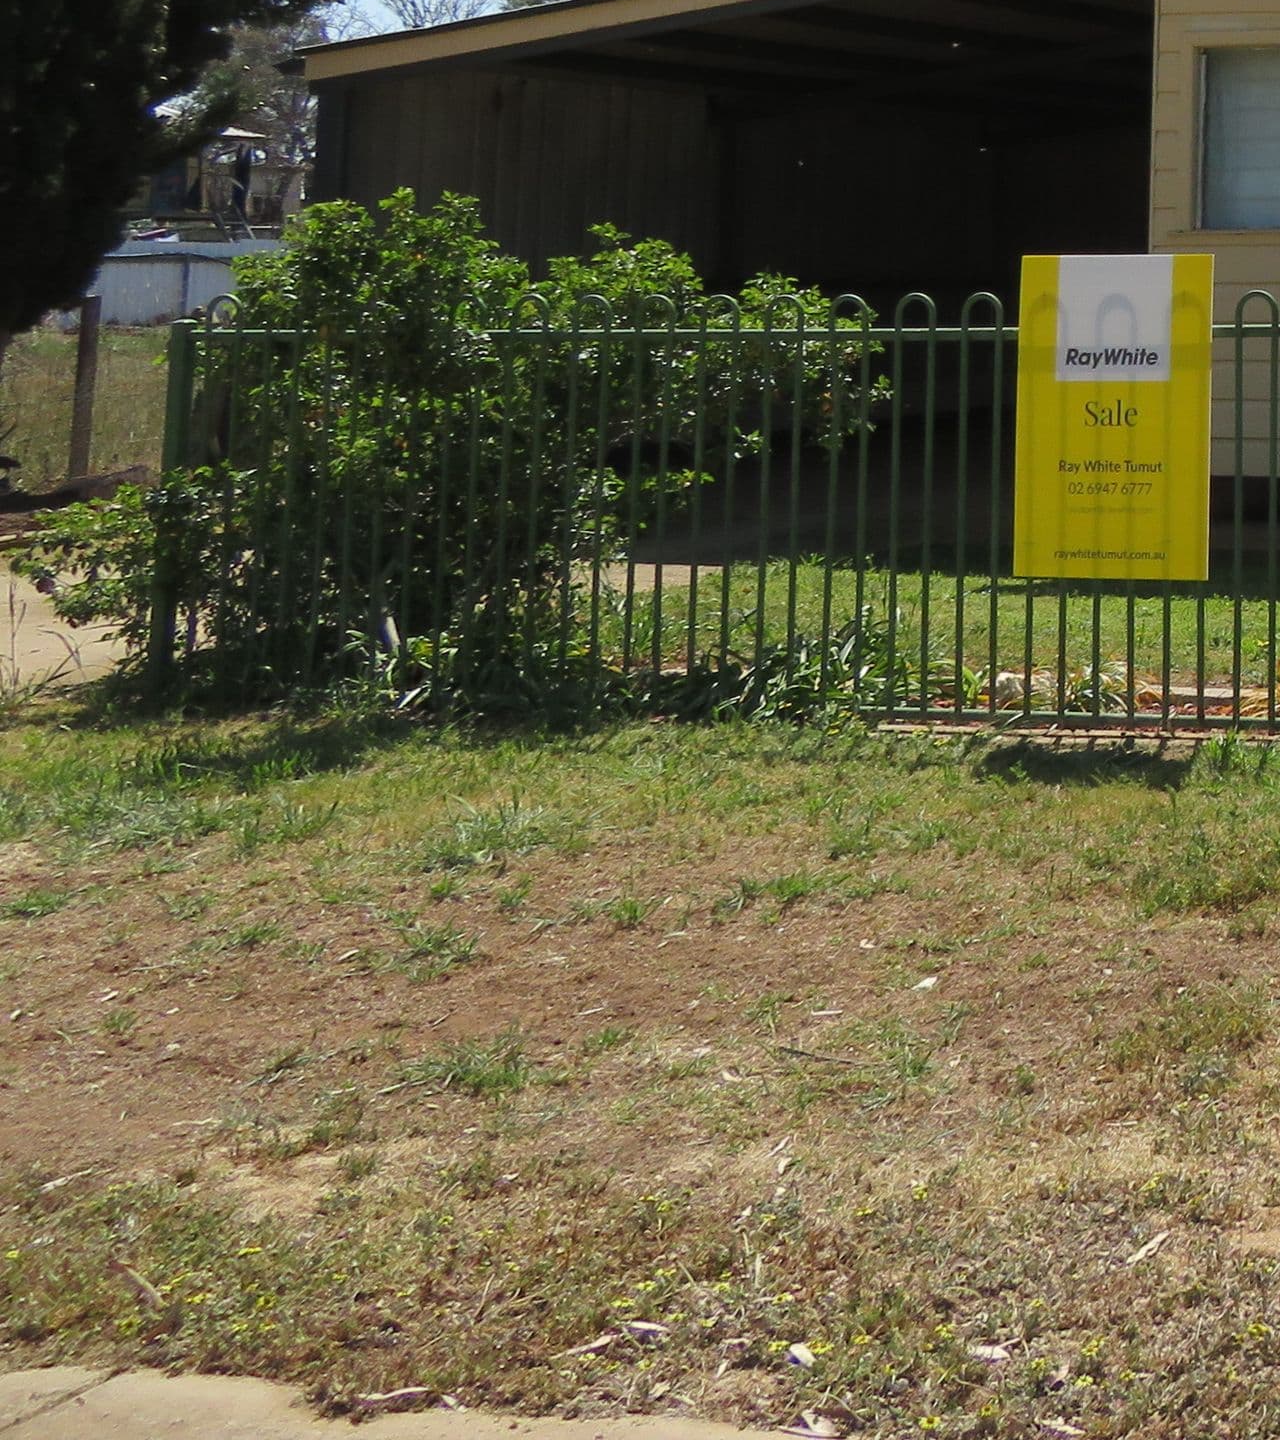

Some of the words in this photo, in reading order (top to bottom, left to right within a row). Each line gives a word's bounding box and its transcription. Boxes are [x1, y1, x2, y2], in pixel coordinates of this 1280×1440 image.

[1084, 400, 1138, 427] Sale
[1058, 460, 1081, 474] Ray
[1084, 460, 1121, 473] White
[1124, 460, 1163, 473] Tumut
[1068, 482, 1084, 495] 02
[1087, 482, 1118, 495] 6947
[1121, 482, 1153, 495] 6777
[1054, 548, 1166, 560] raywhitetumut.com.au
